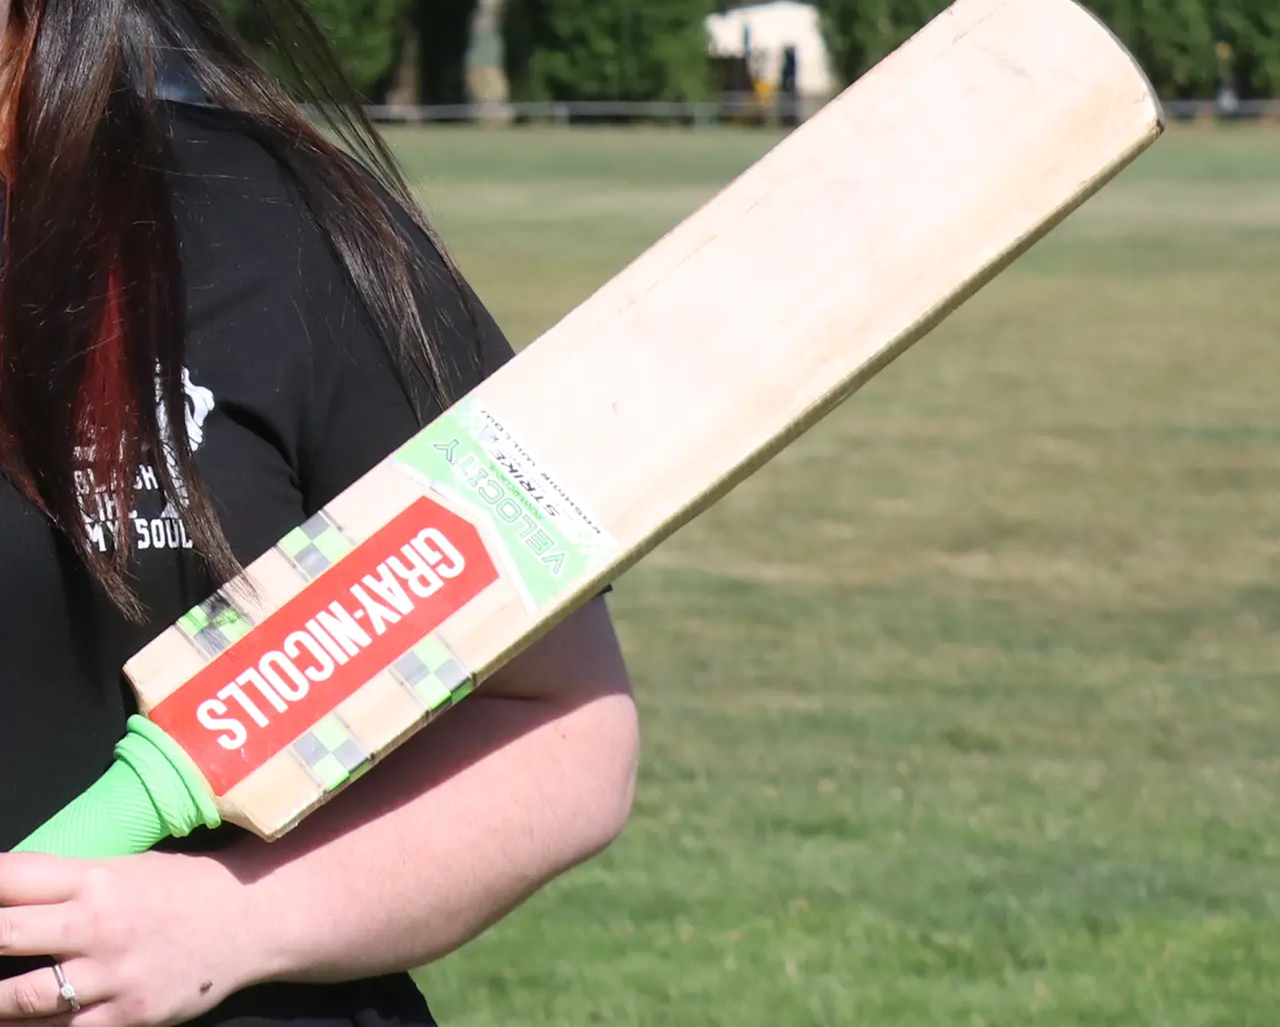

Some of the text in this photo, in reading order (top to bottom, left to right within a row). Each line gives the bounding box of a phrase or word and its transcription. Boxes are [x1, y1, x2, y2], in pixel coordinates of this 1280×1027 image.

[134, 518, 193, 549] SOUL
[432, 438, 566, 575] VELOCITY
[490, 449, 560, 517] STRIKE
[196, 527, 466, 751] GRAY-NICOLLS
